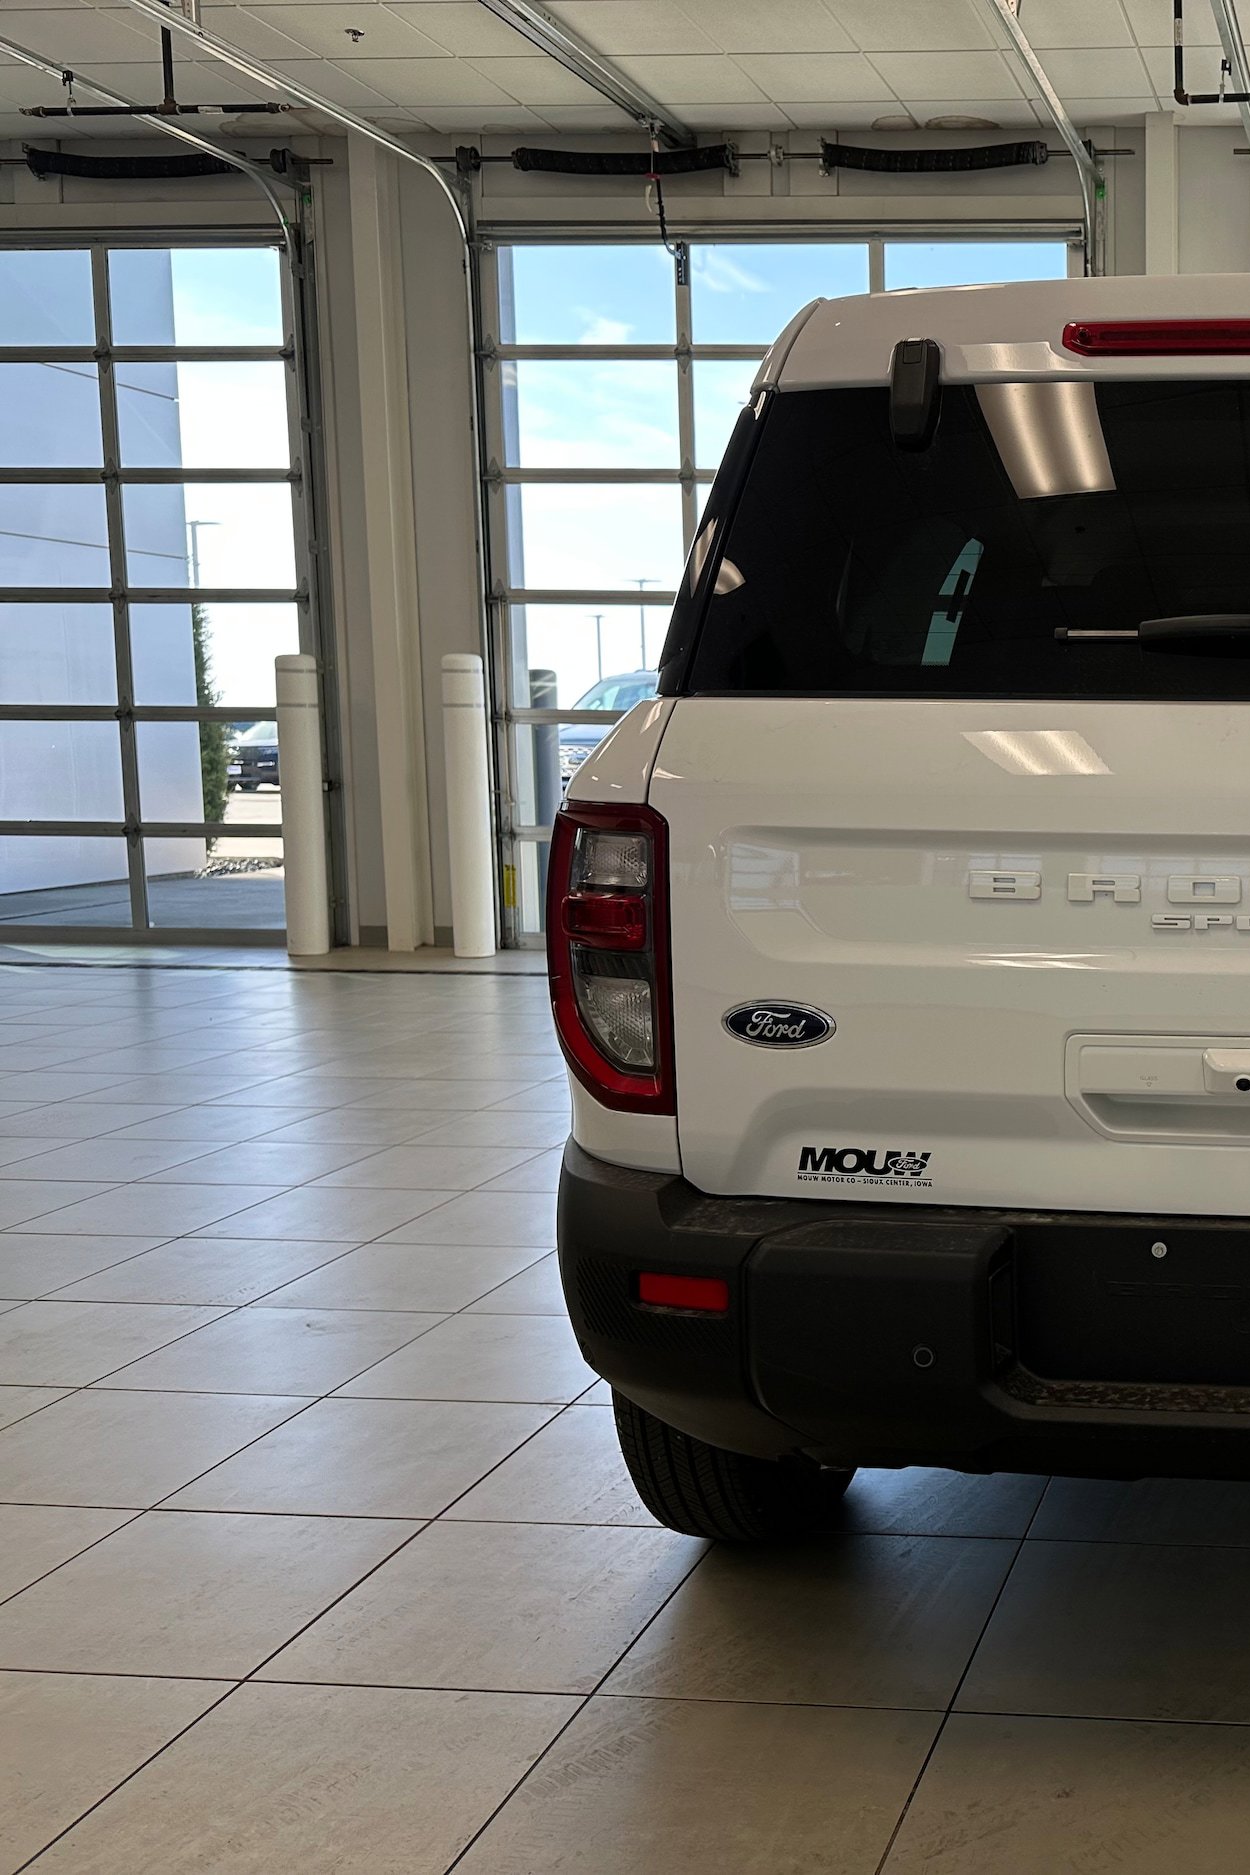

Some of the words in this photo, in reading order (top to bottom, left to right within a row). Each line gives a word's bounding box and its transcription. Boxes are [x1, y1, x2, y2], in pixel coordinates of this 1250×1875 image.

[746, 1011, 806, 1038] Ford
[799, 1147, 931, 1176] MOUW
[896, 1159, 920, 1170] Ford
[821, 1176, 845, 1184] MOTOR
